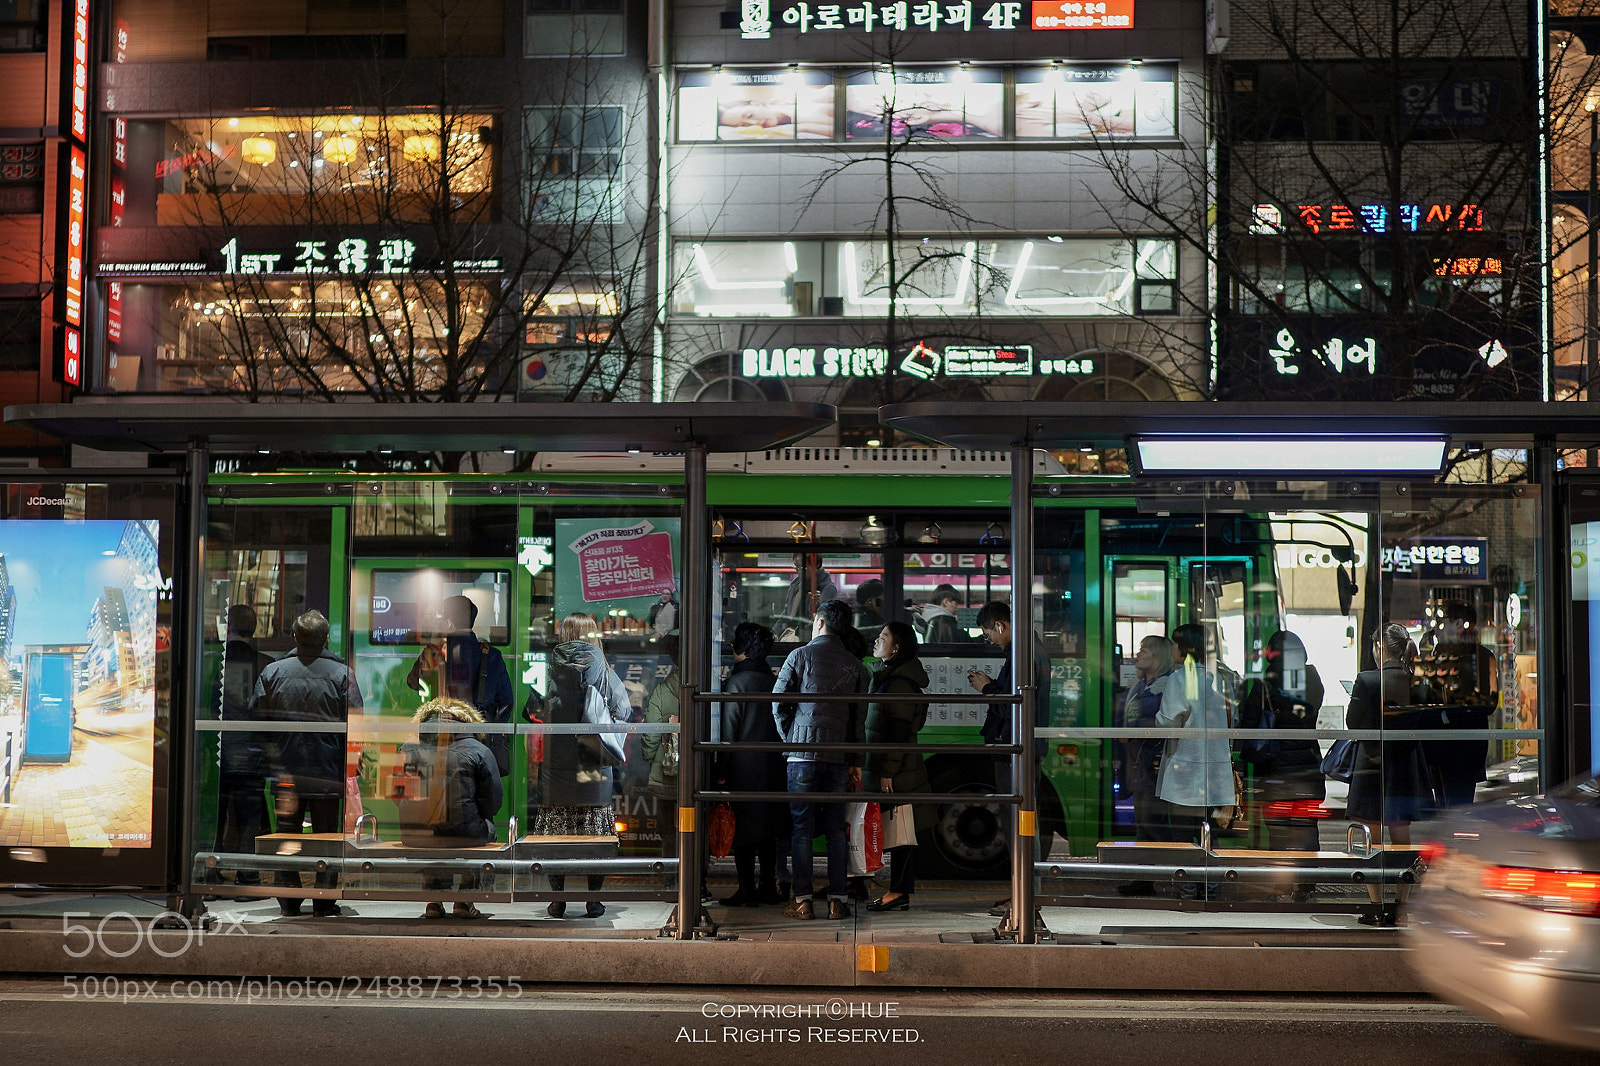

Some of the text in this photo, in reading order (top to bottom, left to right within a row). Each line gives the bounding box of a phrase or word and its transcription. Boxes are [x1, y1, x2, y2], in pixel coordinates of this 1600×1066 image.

[782, 1, 1021, 33] 아로마테라피 4F
[220, 238, 416, 274] 1ST 조용관
[742, 348, 816, 377] BLACK
[27, 497, 73, 506] JCDecaux
[584, 554, 639, 574] 찾아가는
[1410, 546, 1480, 565] 신한은행
[586, 566, 655, 588] 동주민센터
